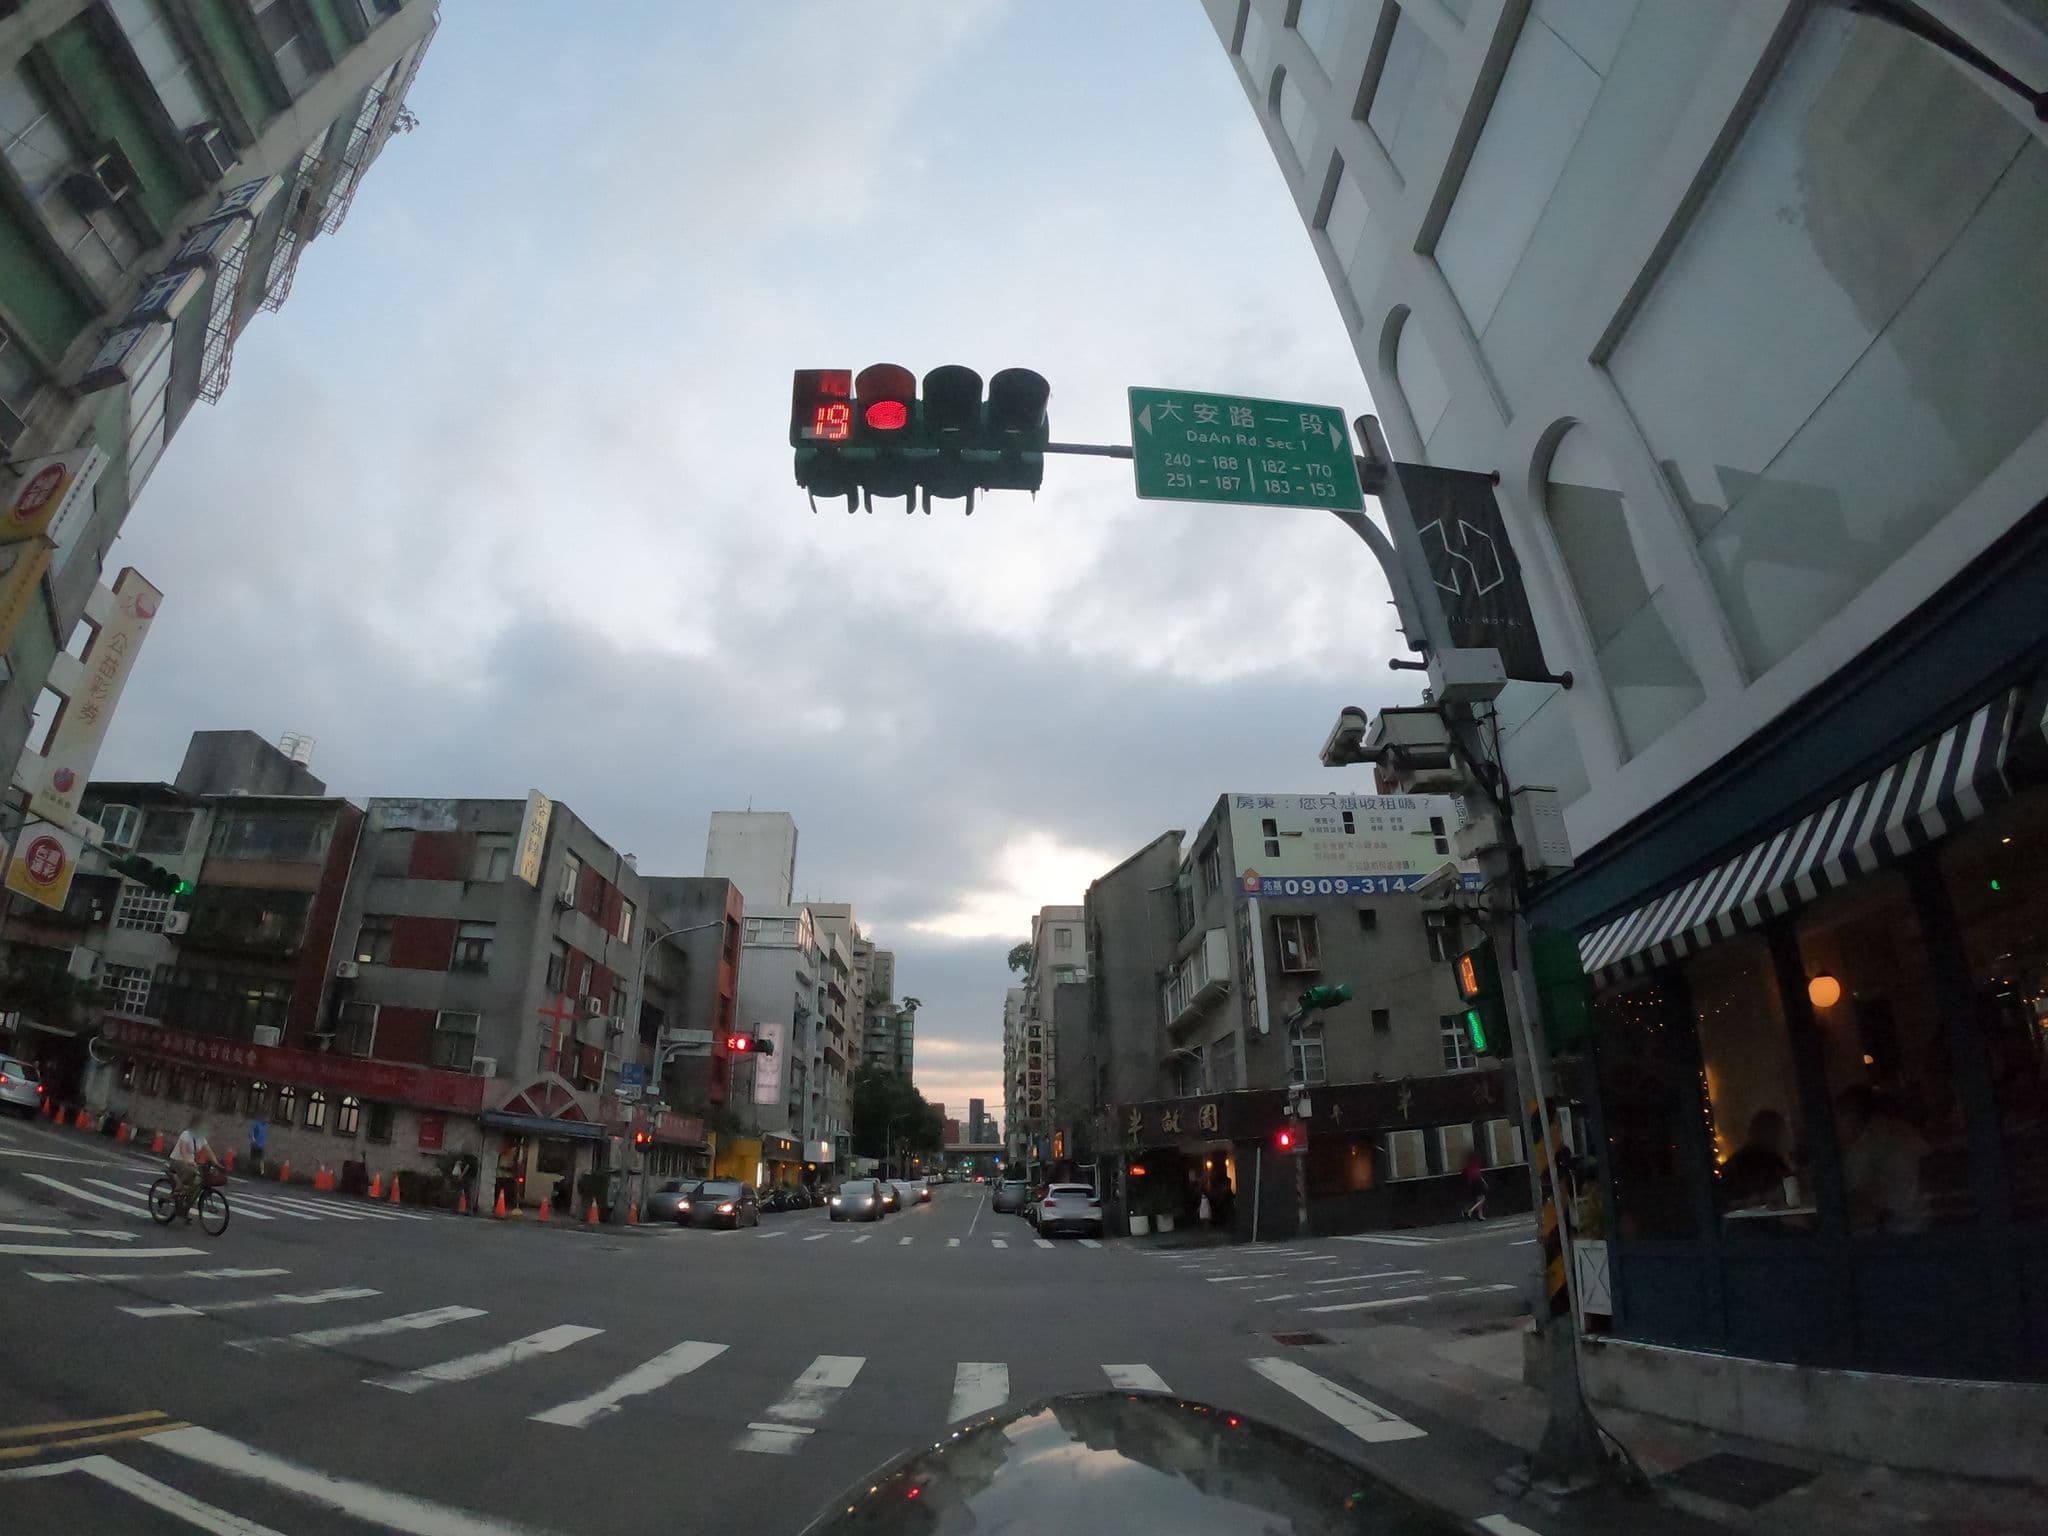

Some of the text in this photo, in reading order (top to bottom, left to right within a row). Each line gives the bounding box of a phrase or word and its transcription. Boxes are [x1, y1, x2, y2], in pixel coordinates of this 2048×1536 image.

[815, 403, 850, 439] 19
[1157, 399, 1325, 436] 大安路一段
[1186, 430, 1231, 445] DaAn
[1236, 434, 1261, 448] Rd.
[1301, 440, 1307, 451] 1
[1163, 452, 1192, 467] 240
[1212, 455, 1239, 470] 188
[1260, 459, 1287, 474] 182
[1306, 463, 1332, 477] 170
[1166, 472, 1193, 488] 251
[1215, 476, 1241, 491] 187
[1263, 479, 1290, 494] 183
[1310, 483, 1336, 498] 153
[1285, 877, 1409, 896] 0909-314
[1127, 1103, 1219, 1143] 半畝園
